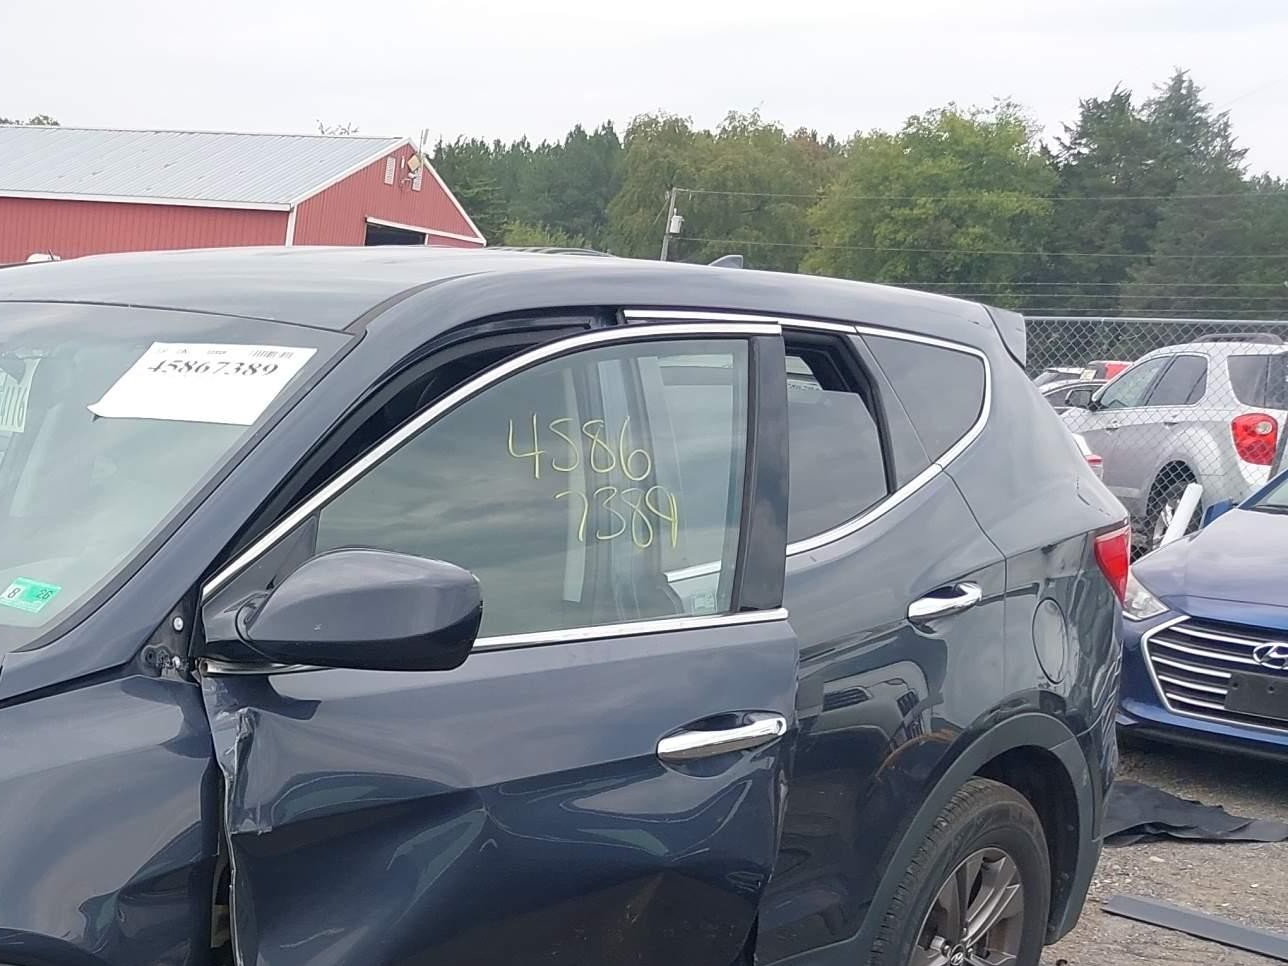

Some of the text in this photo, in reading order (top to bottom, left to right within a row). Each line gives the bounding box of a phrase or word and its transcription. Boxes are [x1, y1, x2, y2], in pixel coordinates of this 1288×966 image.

[147, 358, 279, 376] 45867389
[508, 413, 652, 481] 4586
[554, 486, 678, 548] 7389
[7, 587, 22, 599] 8
